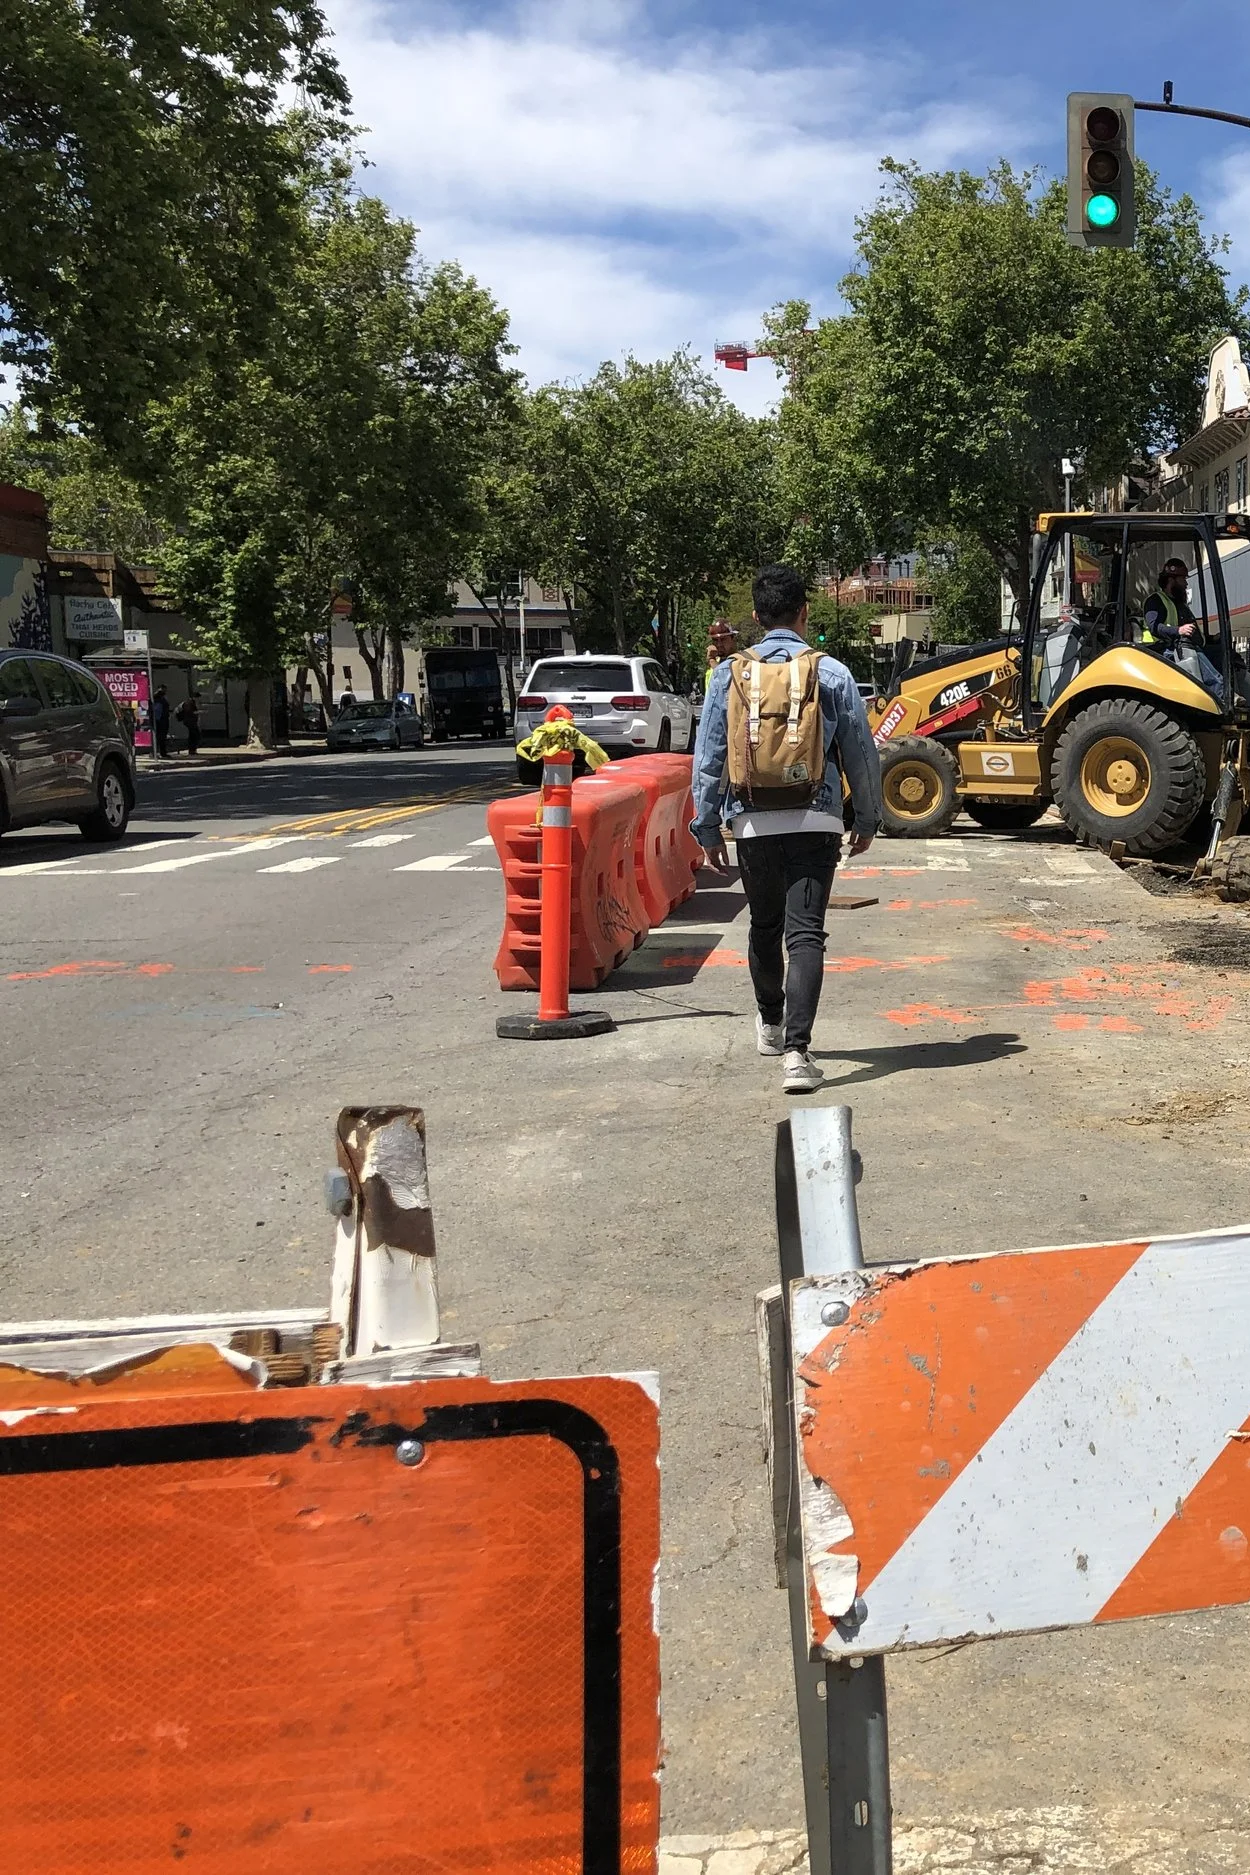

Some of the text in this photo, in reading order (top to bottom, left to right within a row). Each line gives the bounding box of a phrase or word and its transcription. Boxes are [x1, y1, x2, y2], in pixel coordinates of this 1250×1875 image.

[104, 673, 135, 682] MOST
[995, 664, 1012, 680] 66
[939, 681, 971, 707] 420E
